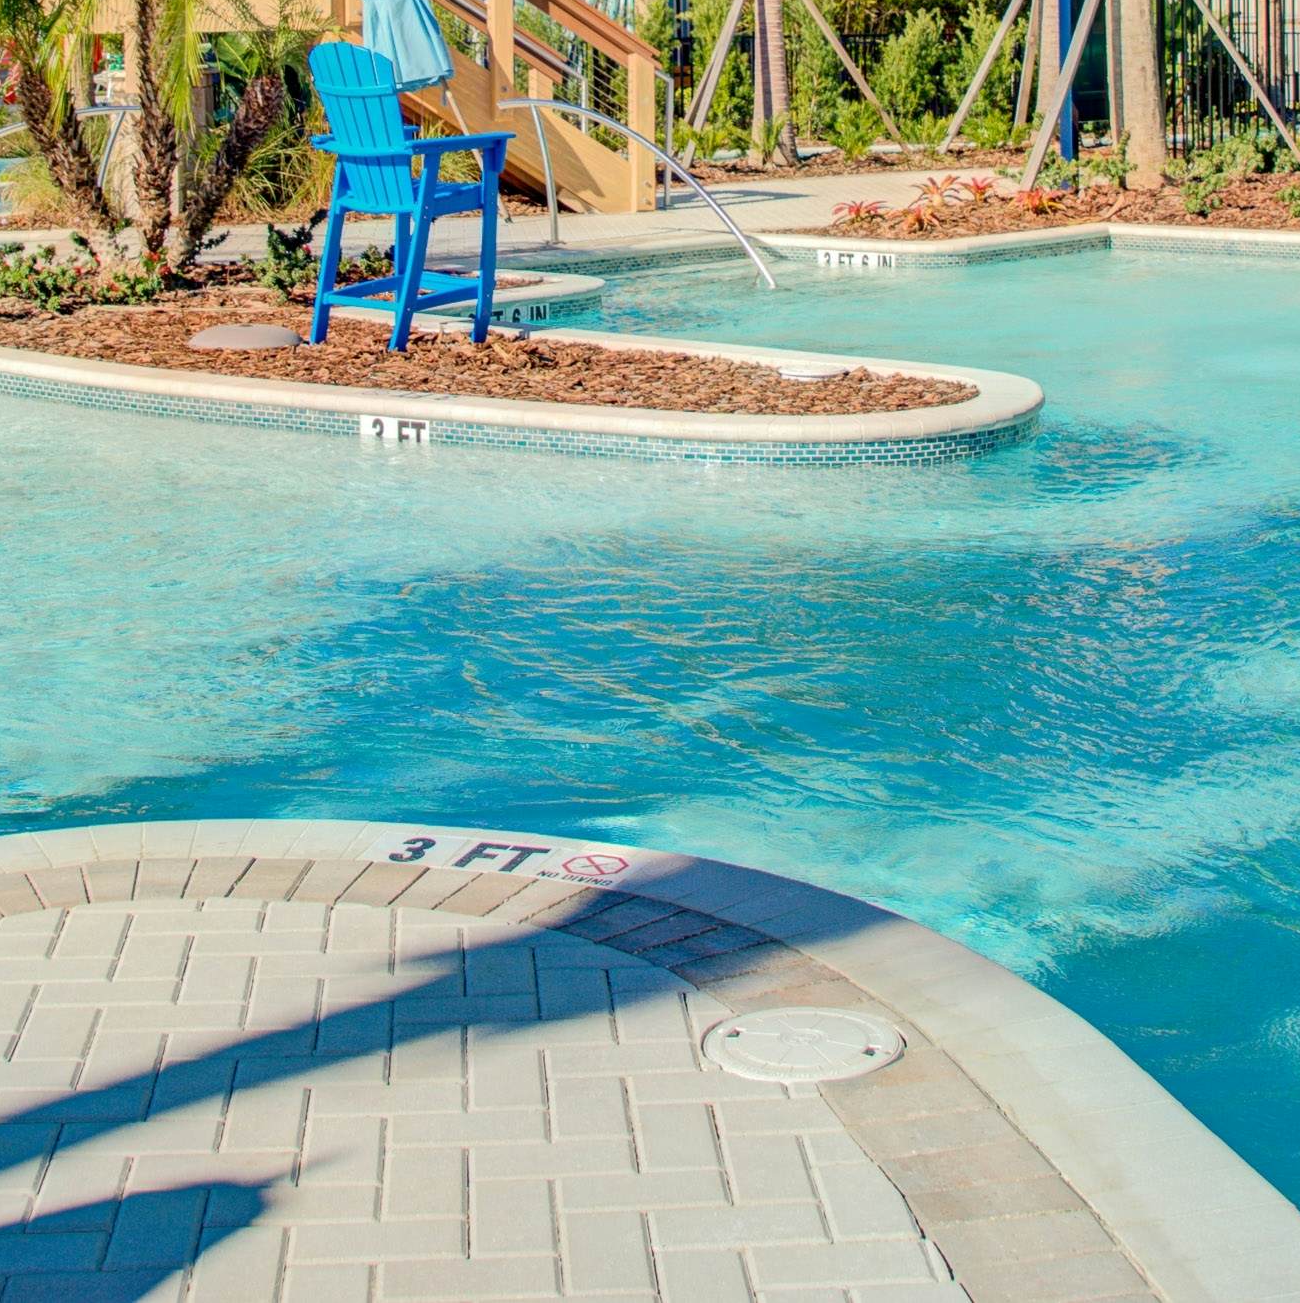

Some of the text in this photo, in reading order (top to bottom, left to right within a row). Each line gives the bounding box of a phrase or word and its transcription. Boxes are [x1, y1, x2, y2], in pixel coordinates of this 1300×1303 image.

[824, 251, 831, 266] 3
[838, 252, 854, 265] FT
[877, 254, 892, 268] IN
[512, 308, 521, 323] 6
[530, 305, 547, 321] IN
[371, 418, 426, 443] 3 FT
[388, 837, 551, 873] 3 FT
[537, 869, 613, 886] NO DIVING
